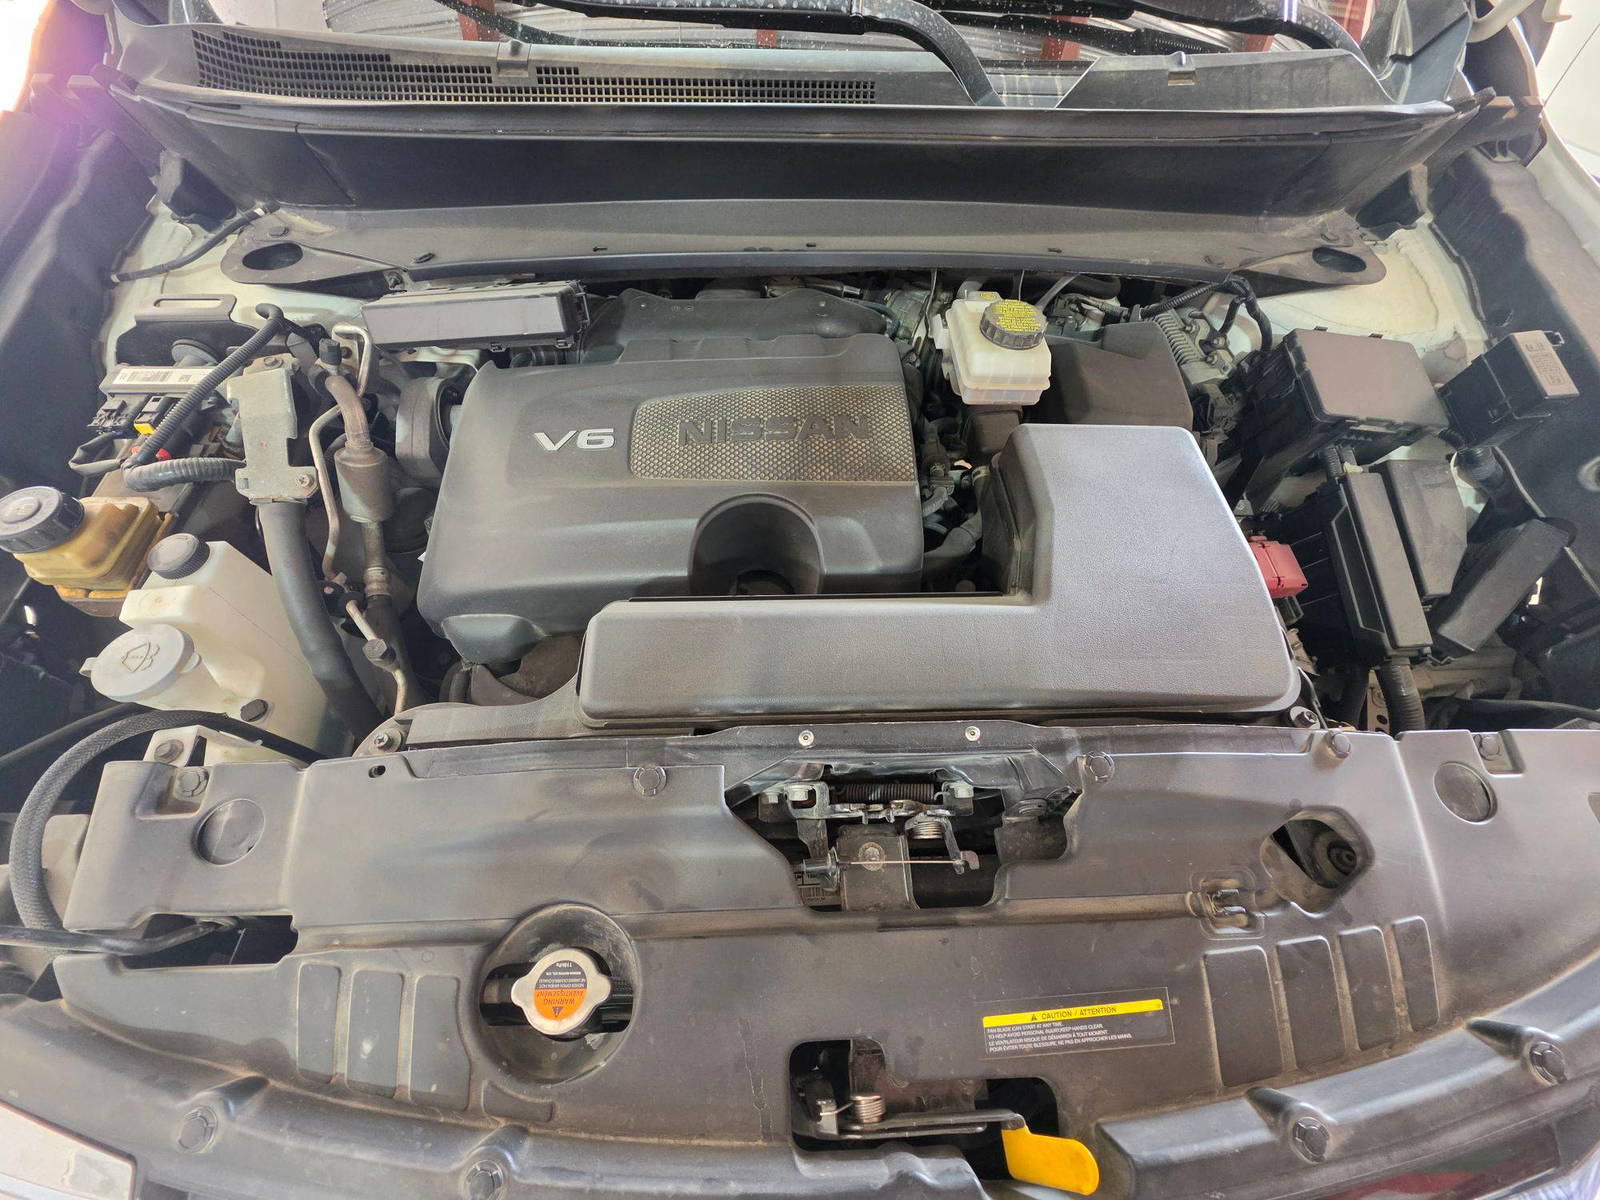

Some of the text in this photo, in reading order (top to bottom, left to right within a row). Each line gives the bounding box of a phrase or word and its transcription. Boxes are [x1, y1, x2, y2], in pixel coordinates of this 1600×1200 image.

[534, 428, 615, 451] V6
[679, 414, 869, 446] NISSAN
[1041, 1010, 1072, 1020] CAUTION
[1080, 1007, 1117, 1016] ATTENTION
